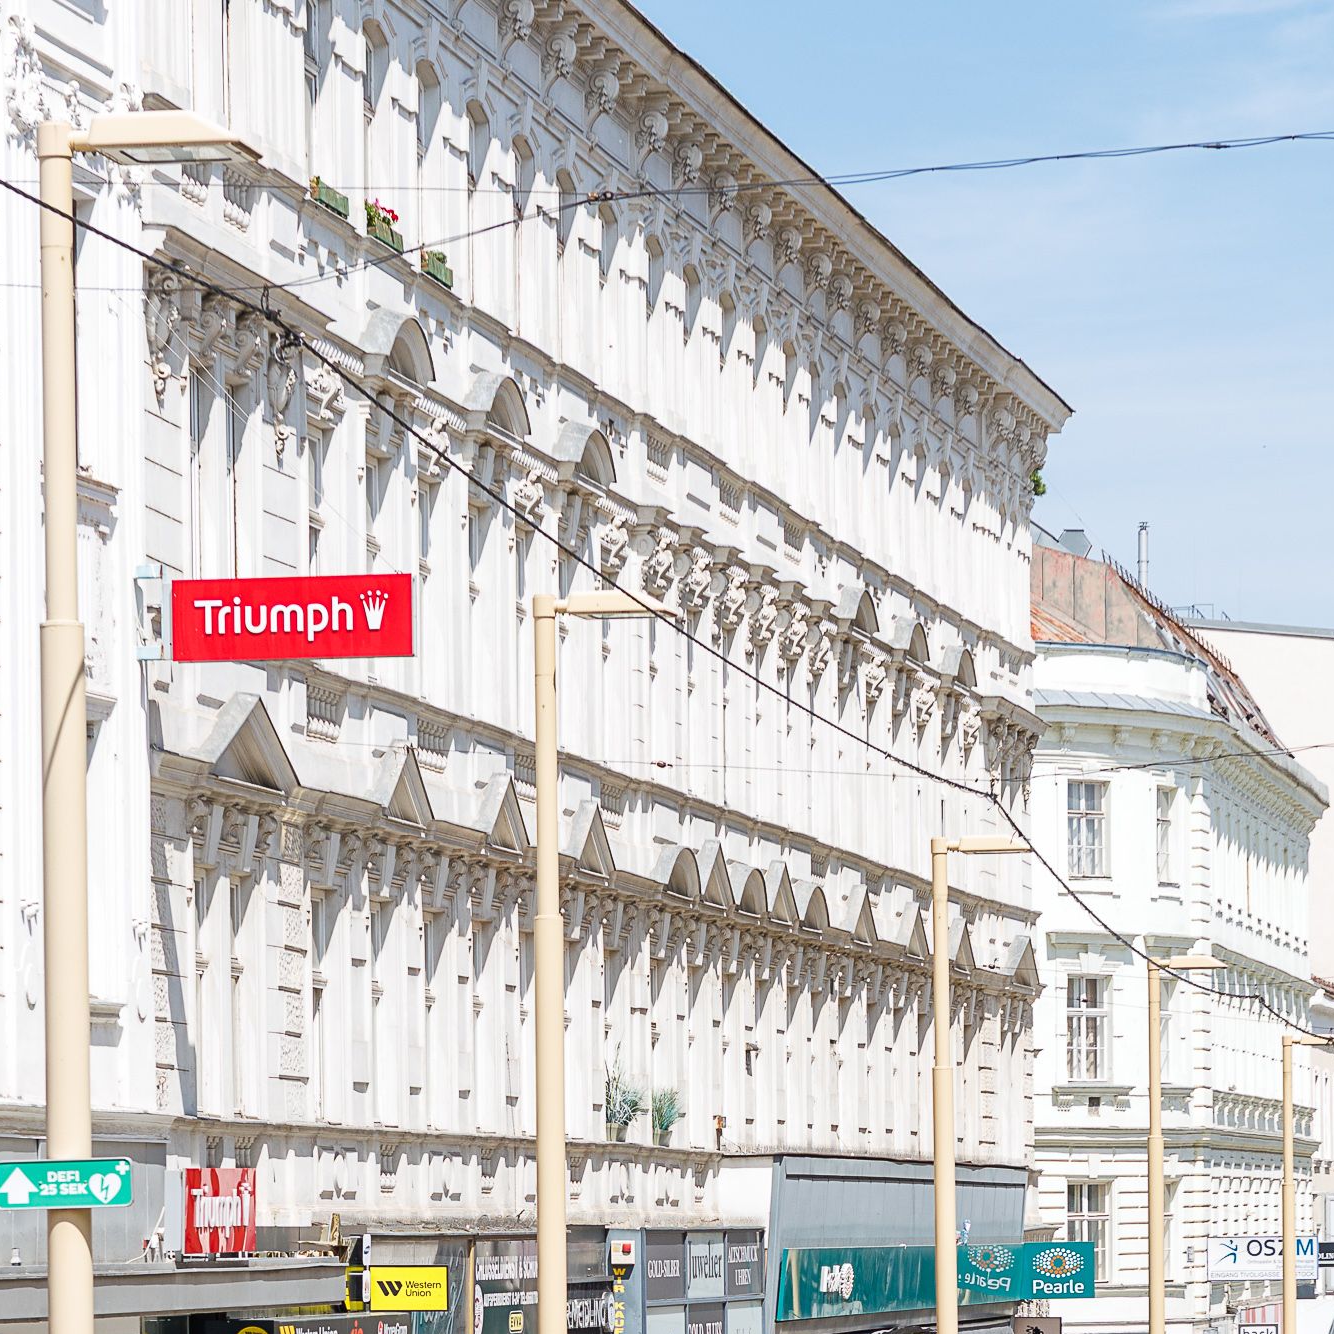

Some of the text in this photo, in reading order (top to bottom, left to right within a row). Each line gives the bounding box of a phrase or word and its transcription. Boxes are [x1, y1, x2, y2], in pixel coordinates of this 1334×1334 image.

[194, 596, 354, 642] Triumph
[46, 1170, 81, 1182] DEFI
[39, 1182, 89, 1196] 25 SEK
[405, 1280, 442, 1289] Western
[735, 1269, 752, 1286] UHREN
[405, 1289, 432, 1298] Union
[1032, 1279, 1085, 1294] Pearle
